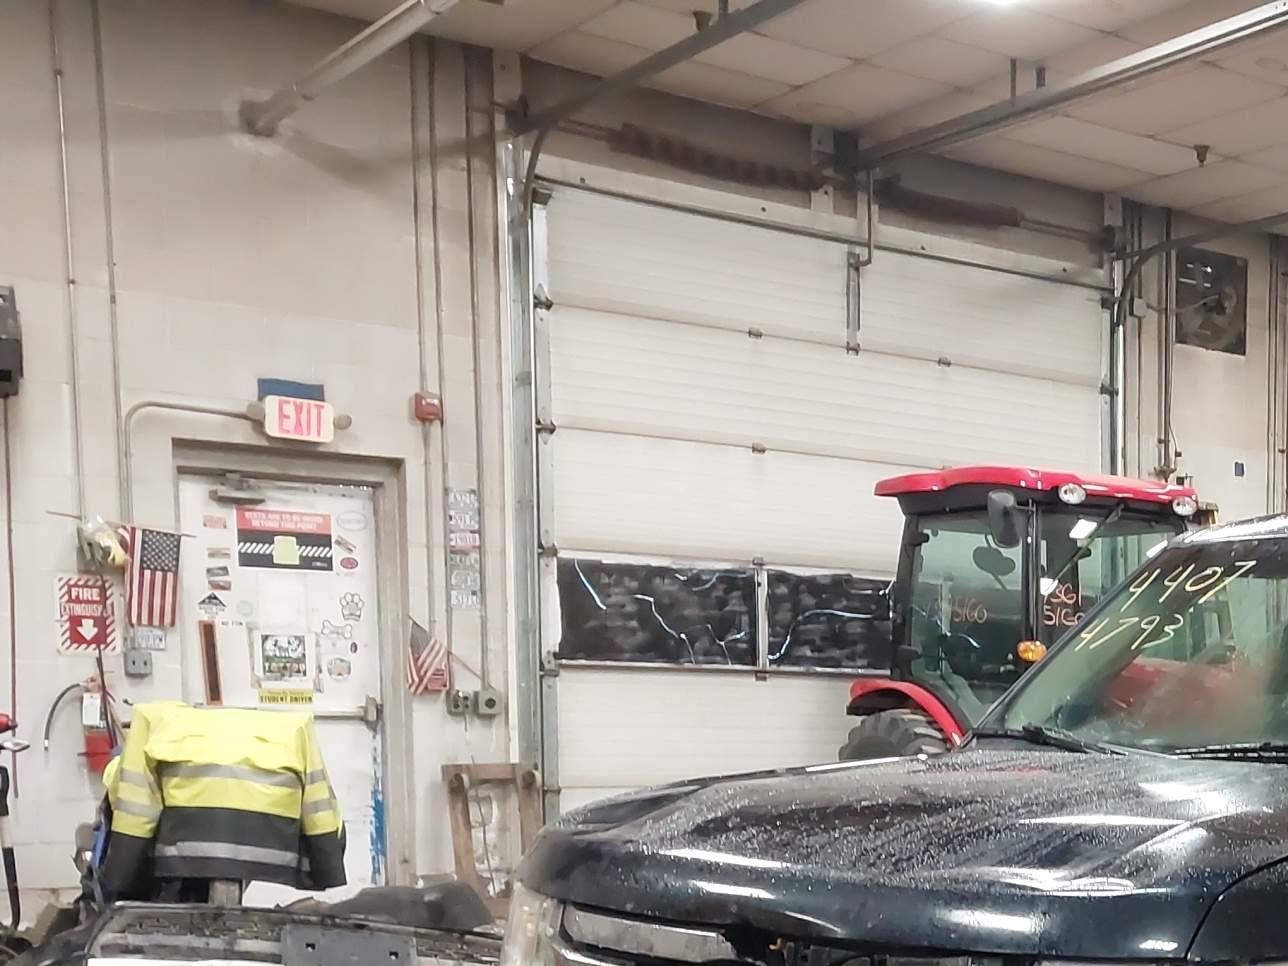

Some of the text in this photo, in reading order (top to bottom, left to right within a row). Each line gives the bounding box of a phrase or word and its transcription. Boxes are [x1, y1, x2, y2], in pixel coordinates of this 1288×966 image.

[278, 399, 325, 437] EXIT
[71, 587, 100, 601] FIRE
[1121, 561, 1256, 613] 4407
[1075, 614, 1184, 651] 4793
[260, 695, 313, 703] STUDENT DRIVER
